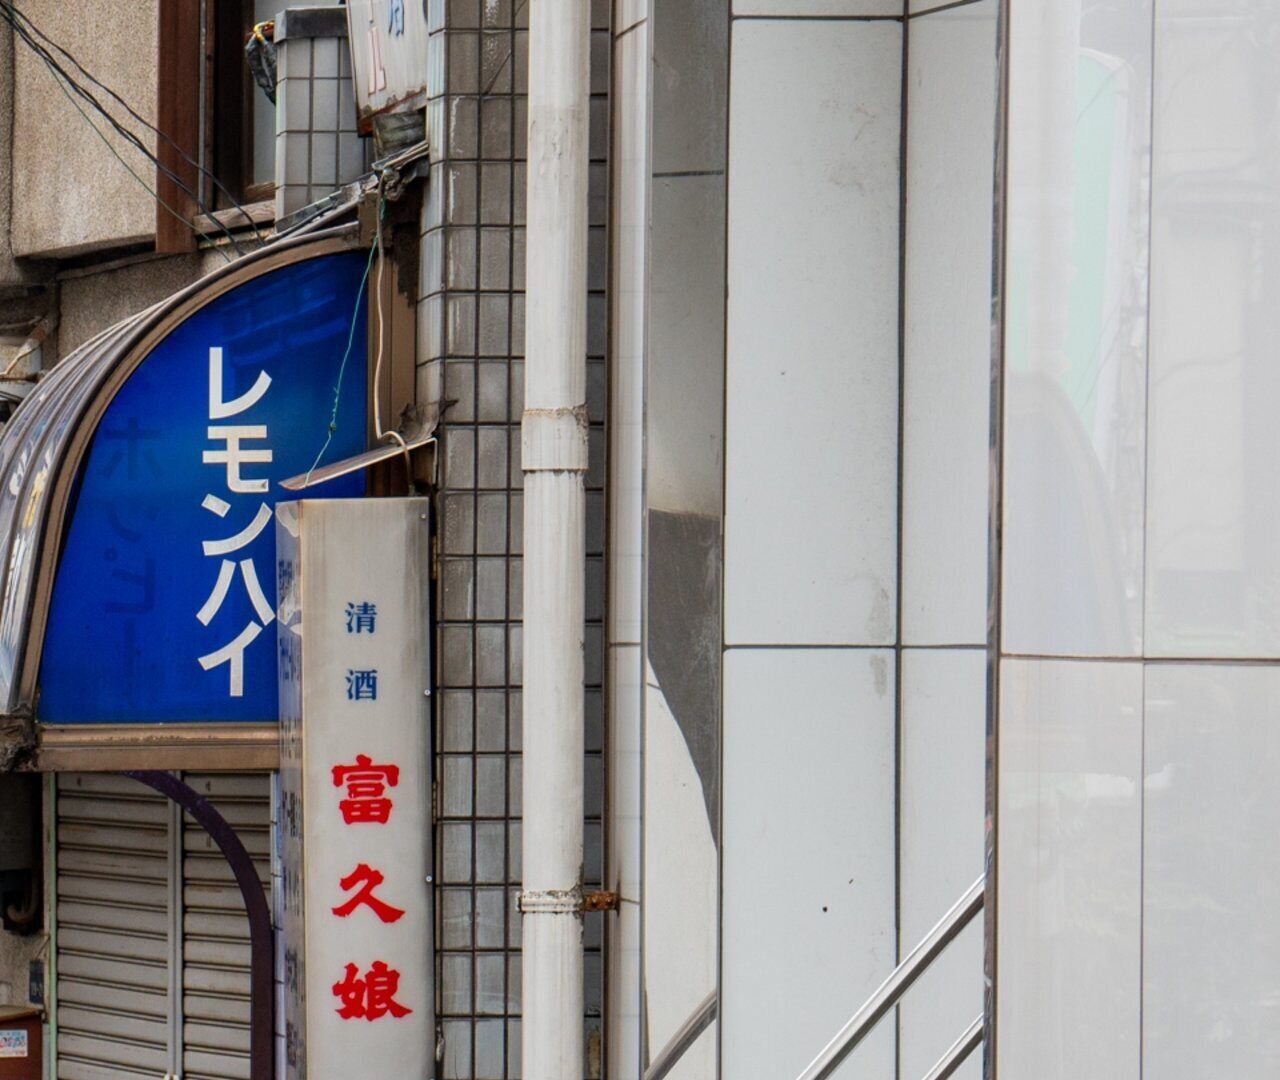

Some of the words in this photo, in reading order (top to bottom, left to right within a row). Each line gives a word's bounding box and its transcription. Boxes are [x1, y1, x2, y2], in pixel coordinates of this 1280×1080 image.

[196, 346, 276, 698] レモンハイ
[345, 601, 378, 701] 清酒
[331, 754, 414, 1022] 富久娘
